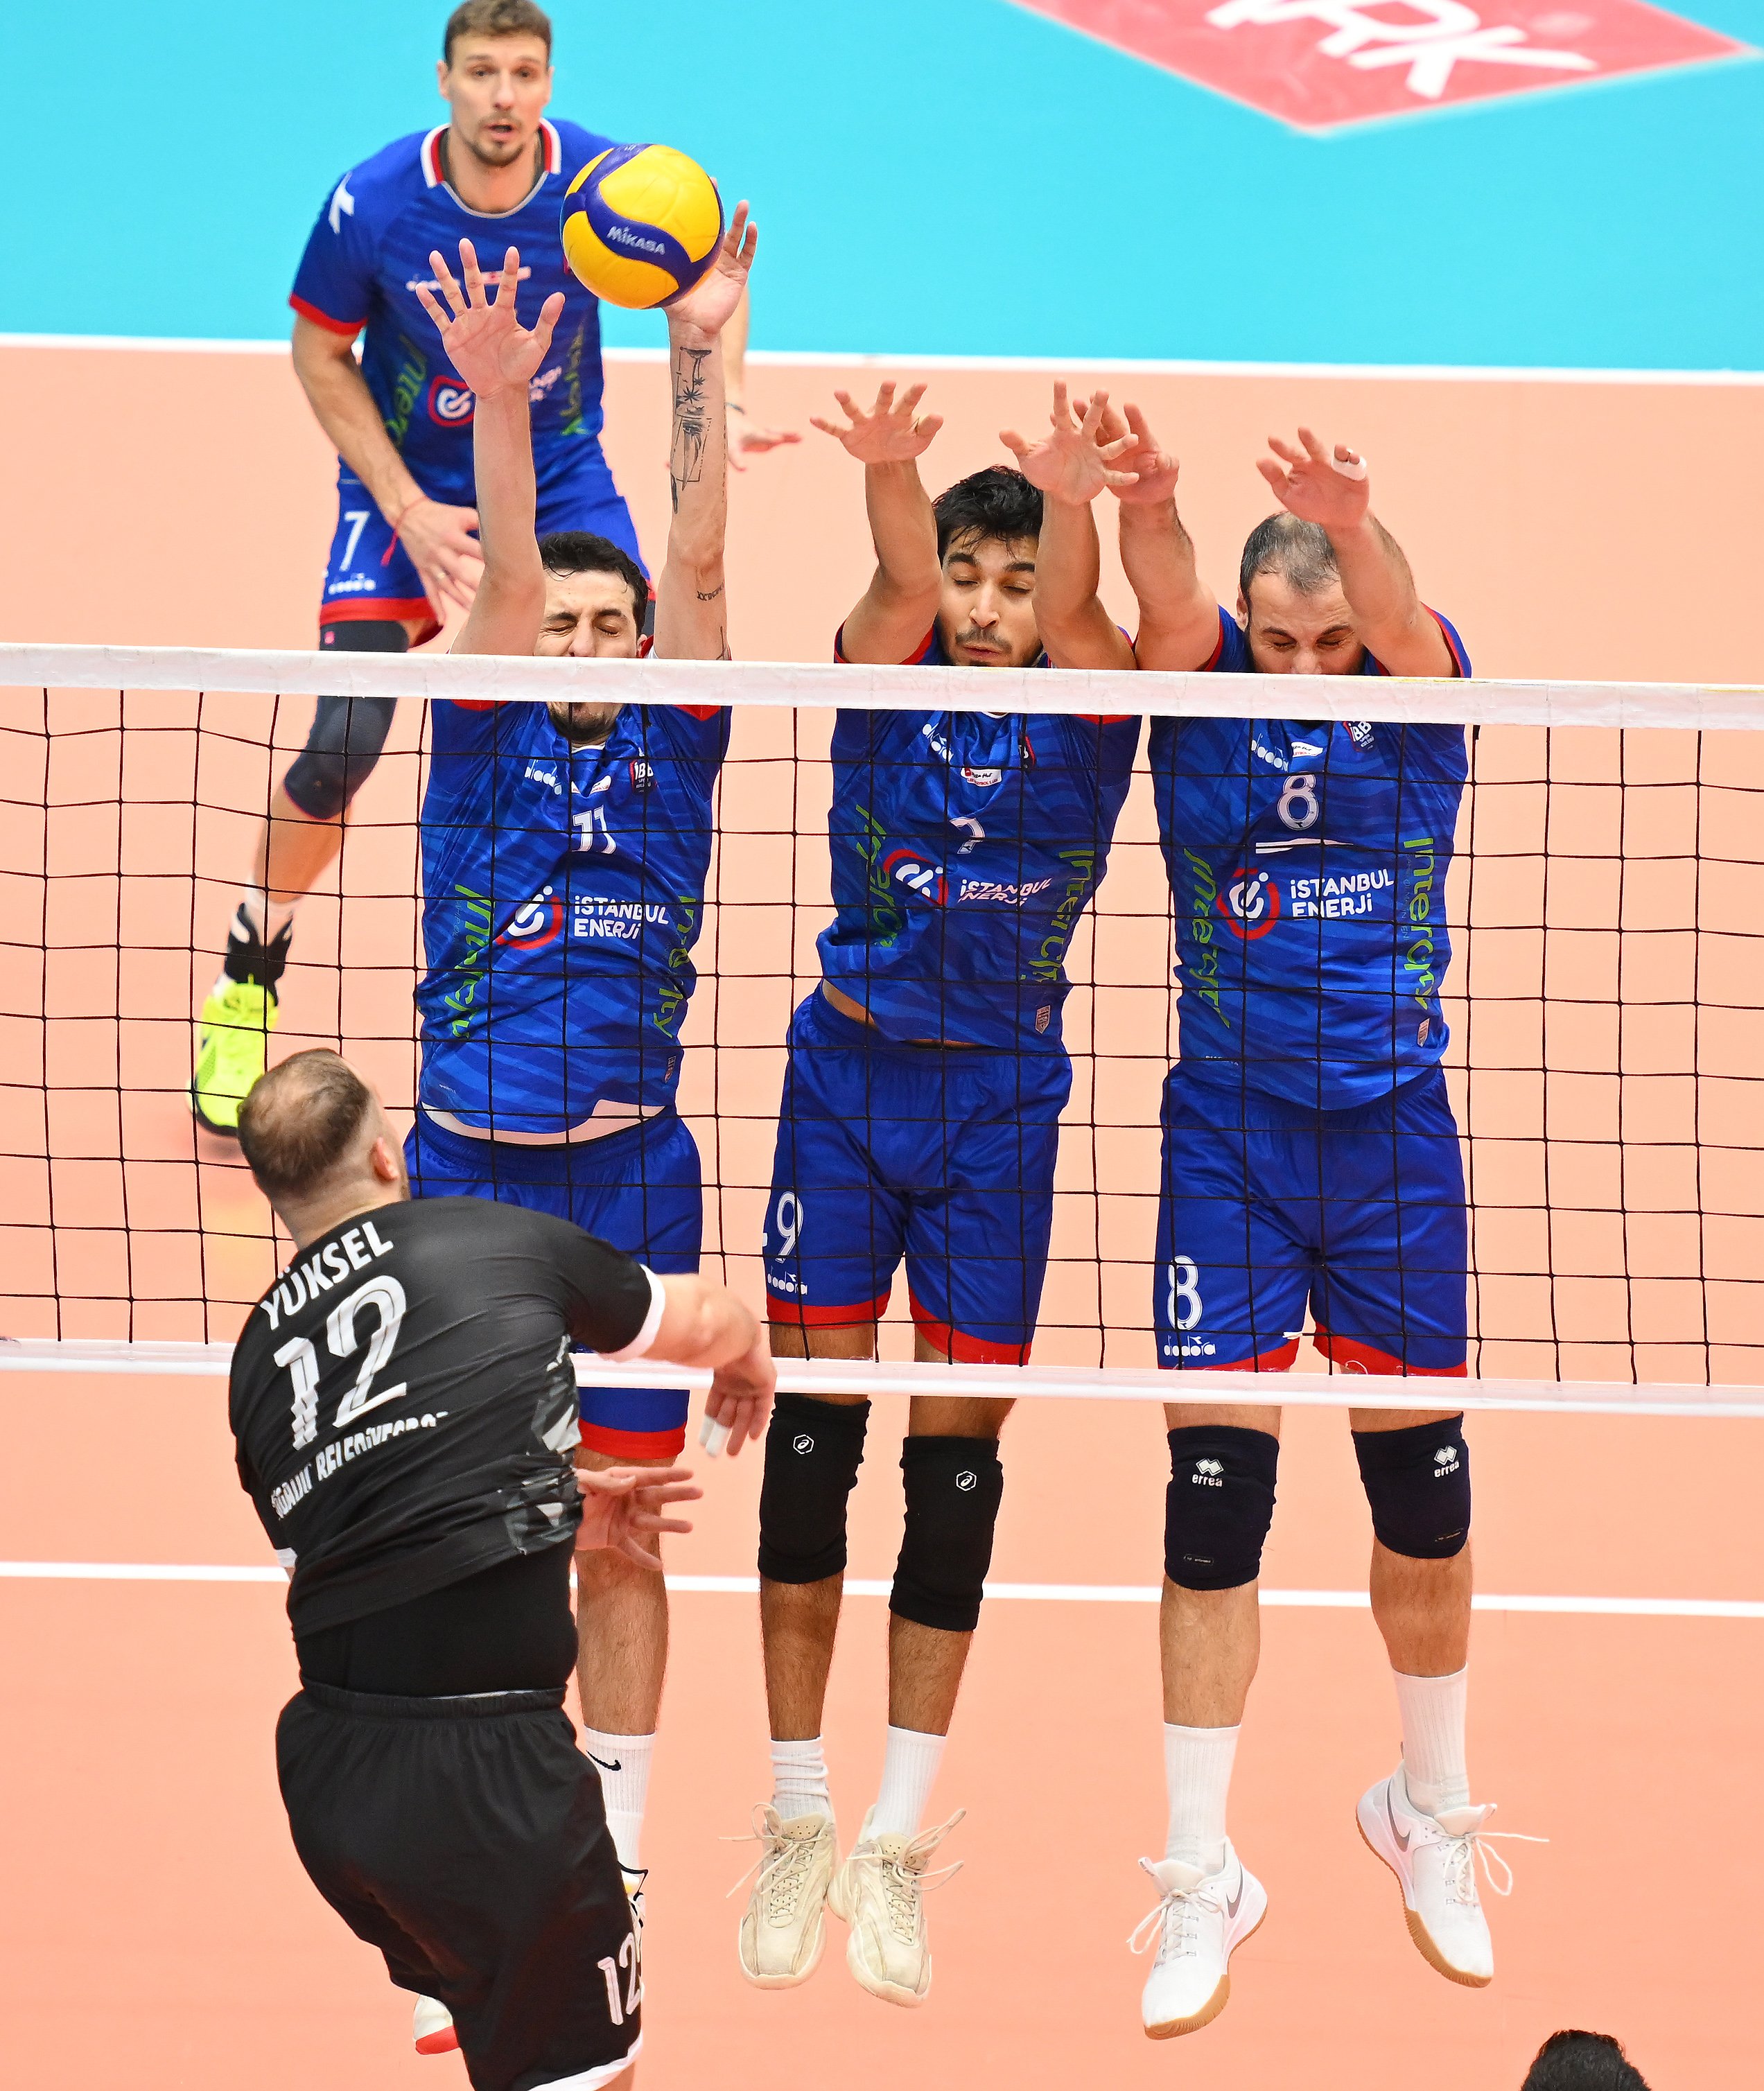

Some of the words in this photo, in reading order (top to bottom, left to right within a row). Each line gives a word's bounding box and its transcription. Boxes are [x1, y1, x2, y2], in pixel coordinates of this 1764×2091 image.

[339, 511, 371, 571] 7
[1277, 771, 1319, 830] 8
[776, 1191, 804, 1263] 9
[260, 1221, 393, 1330] YÜKSEL
[1167, 1255, 1203, 1331] 8
[273, 1275, 407, 1451] 12
[1164, 1335, 1216, 1356] diadora
[597, 1932, 640, 2025] 12
